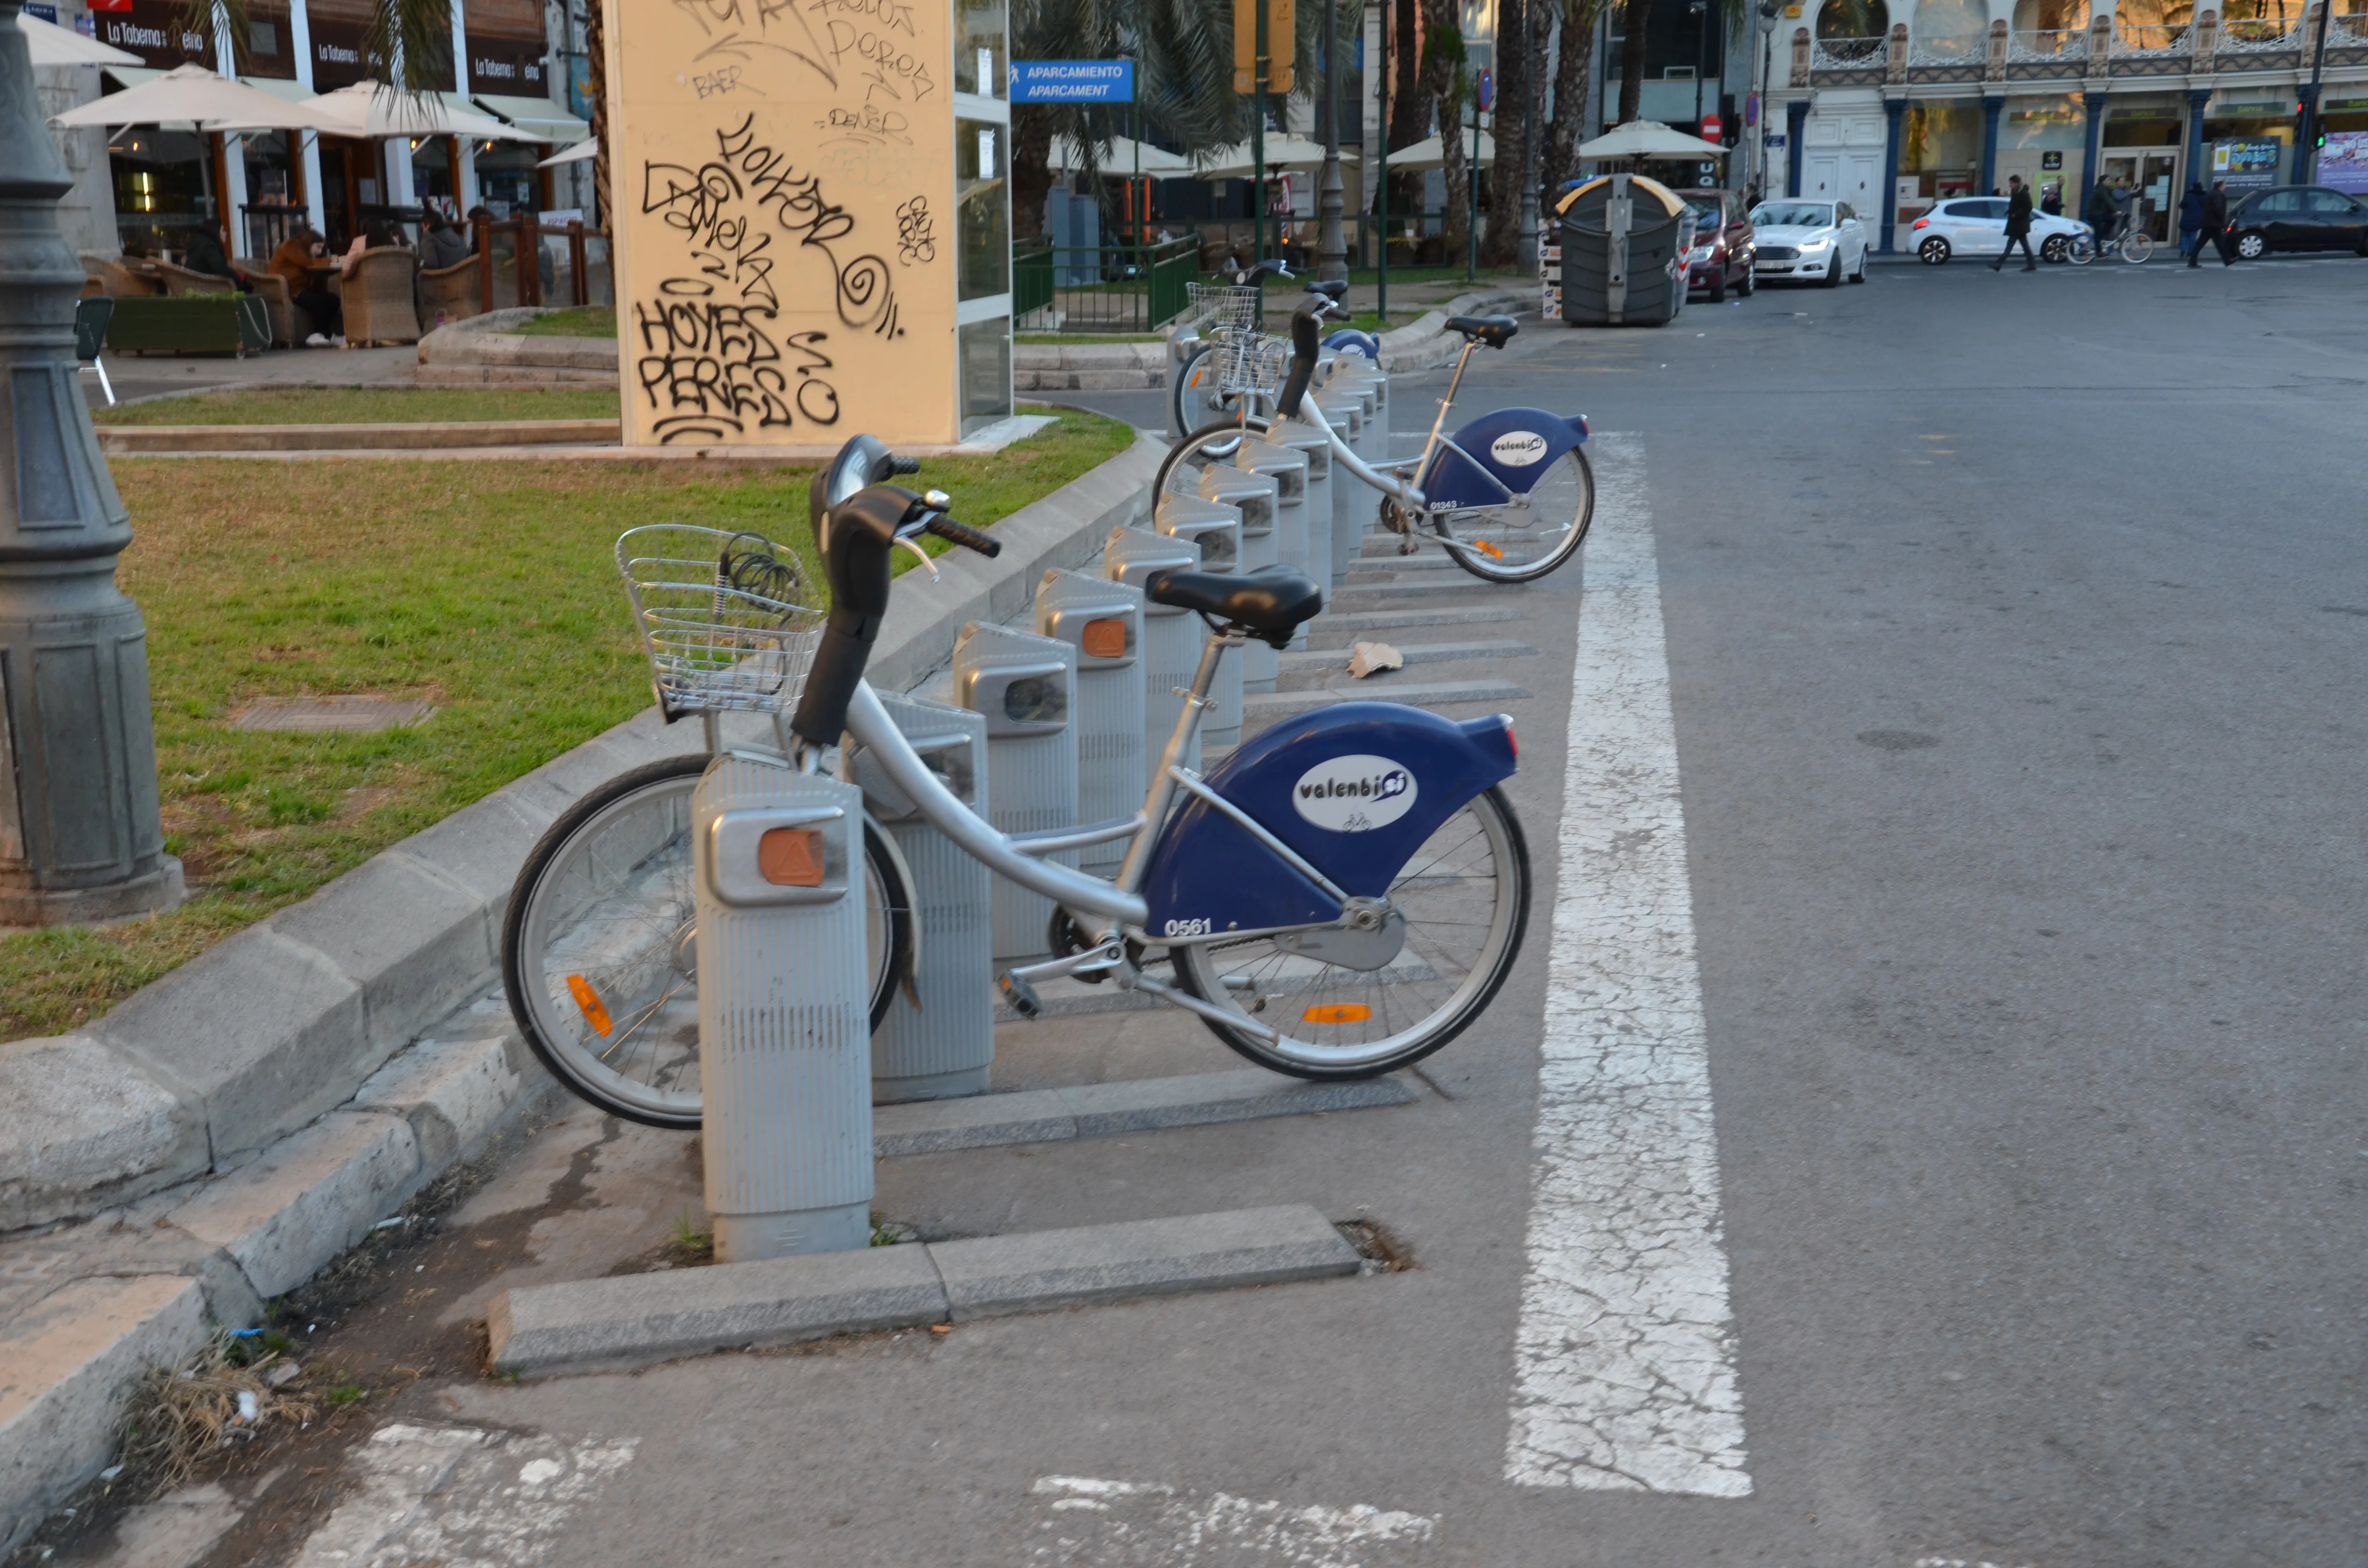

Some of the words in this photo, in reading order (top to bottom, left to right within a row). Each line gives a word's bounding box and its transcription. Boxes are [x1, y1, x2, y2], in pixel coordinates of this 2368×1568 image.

[107, 21, 120, 43] La
[120, 22, 160, 48] Taberna
[319, 44, 328, 61] La
[328, 45, 354, 63] Taberna
[476, 58, 484, 76] La
[484, 59, 511, 78] Taberna
[1027, 66, 1122, 79] APARCAMIENTO
[1028, 85, 1110, 97] APARCAMENT
[1300, 772, 1406, 799] valenbisi
[1164, 918, 1211, 937] 0561
